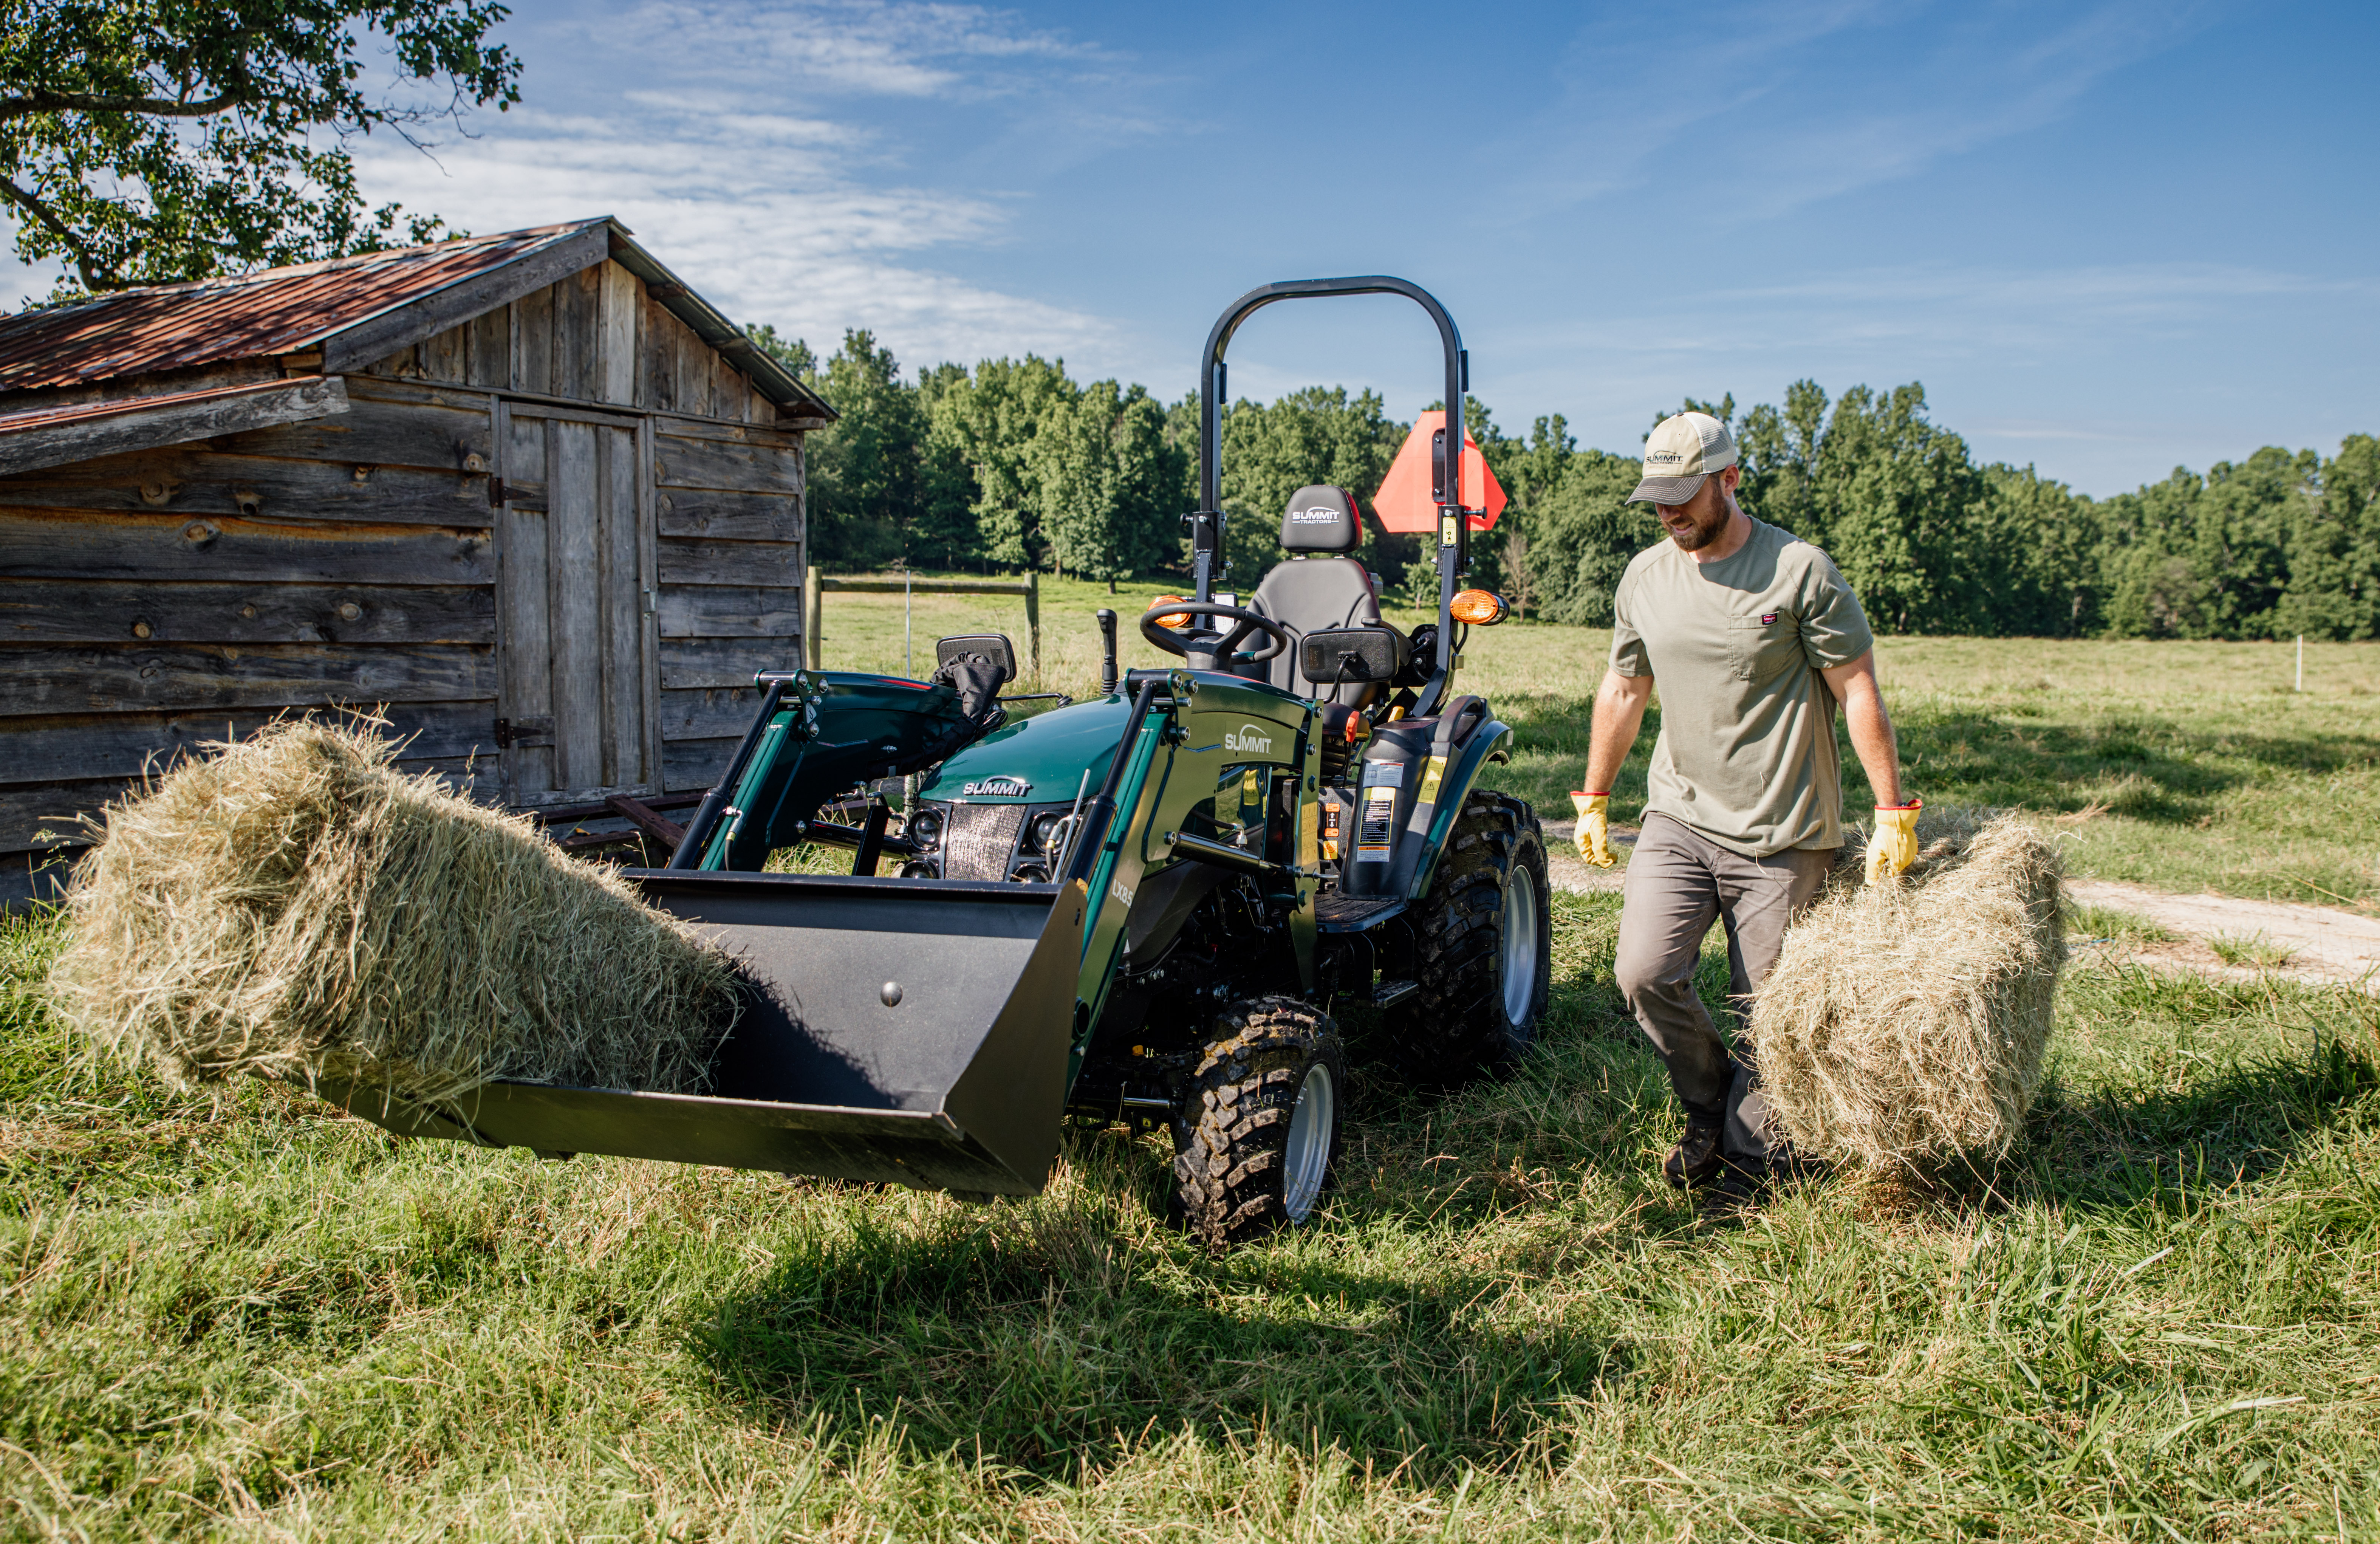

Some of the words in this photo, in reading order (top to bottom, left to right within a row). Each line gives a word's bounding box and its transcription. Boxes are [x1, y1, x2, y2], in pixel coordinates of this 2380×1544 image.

[1646, 451, 1683, 462] SUMMIT
[1292, 506, 1340, 520] SUMMIT
[1225, 724, 1272, 753] SUMMIT
[963, 775, 1031, 796] SUMMIT
[1112, 878, 1133, 908] LX85
